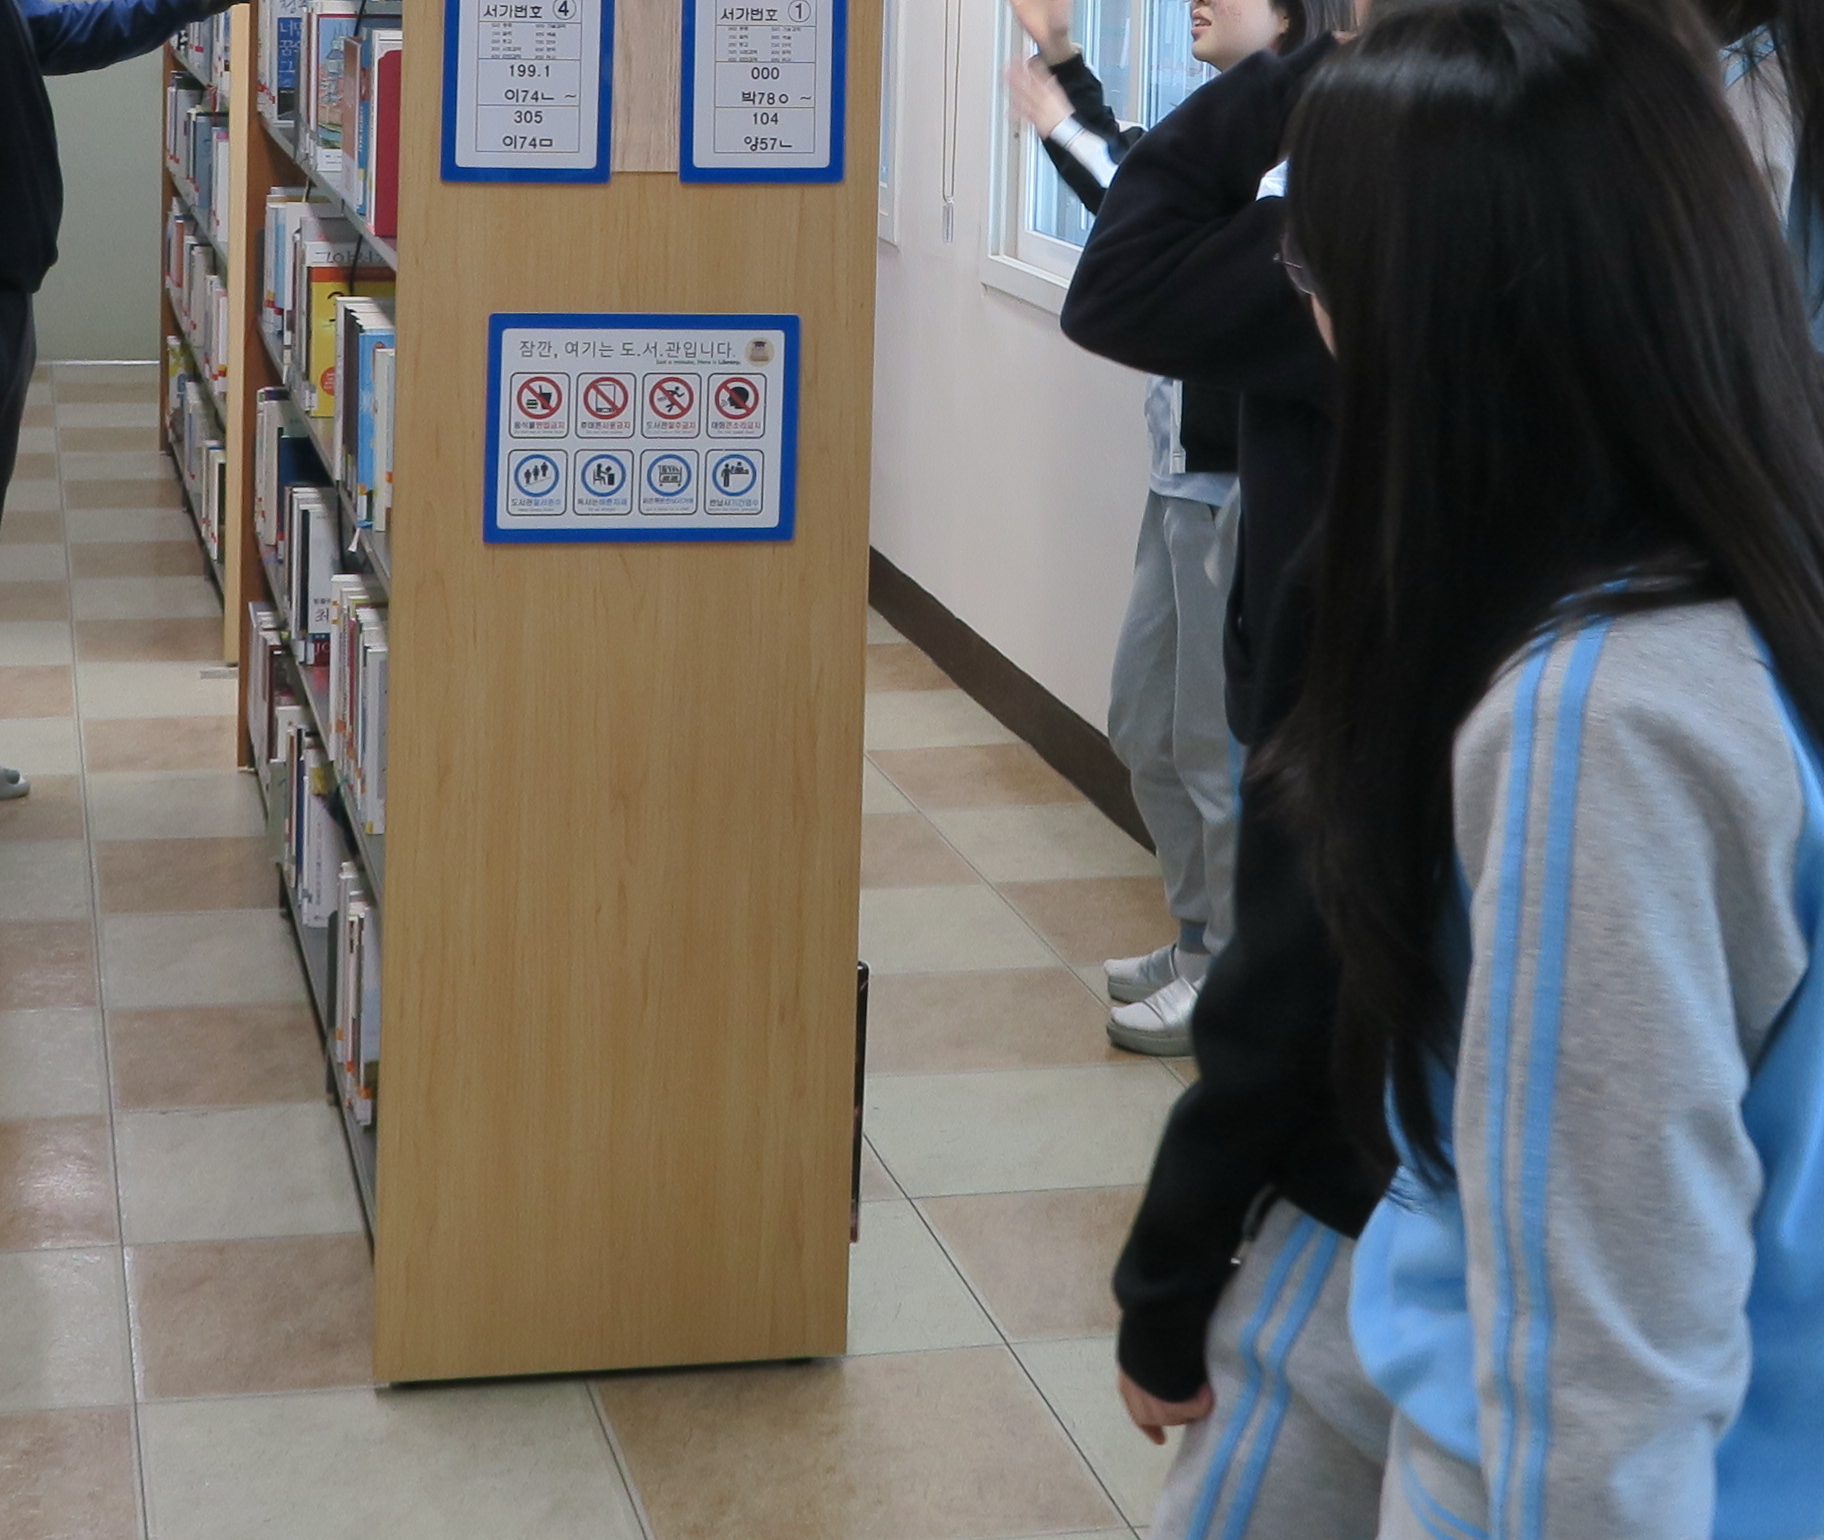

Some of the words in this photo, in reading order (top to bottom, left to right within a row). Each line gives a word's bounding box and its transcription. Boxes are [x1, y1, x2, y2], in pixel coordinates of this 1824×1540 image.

[483, 4, 542, 19] 서가번호
[720, 8, 778, 22] 서가번호
[509, 64, 550, 78] 199.1
[751, 67, 780, 80] 000
[504, 89, 555, 103] 이74ㄴ
[514, 110, 543, 124] 305
[752, 112, 779, 125] 104
[502, 135, 553, 149] 이74ㅁ
[744, 136, 792, 151] 양57ㄴ
[519, 341, 558, 358] 잠깐,
[564, 341, 615, 359] 여기는
[620, 340, 736, 359] 도.서.관입니다.
